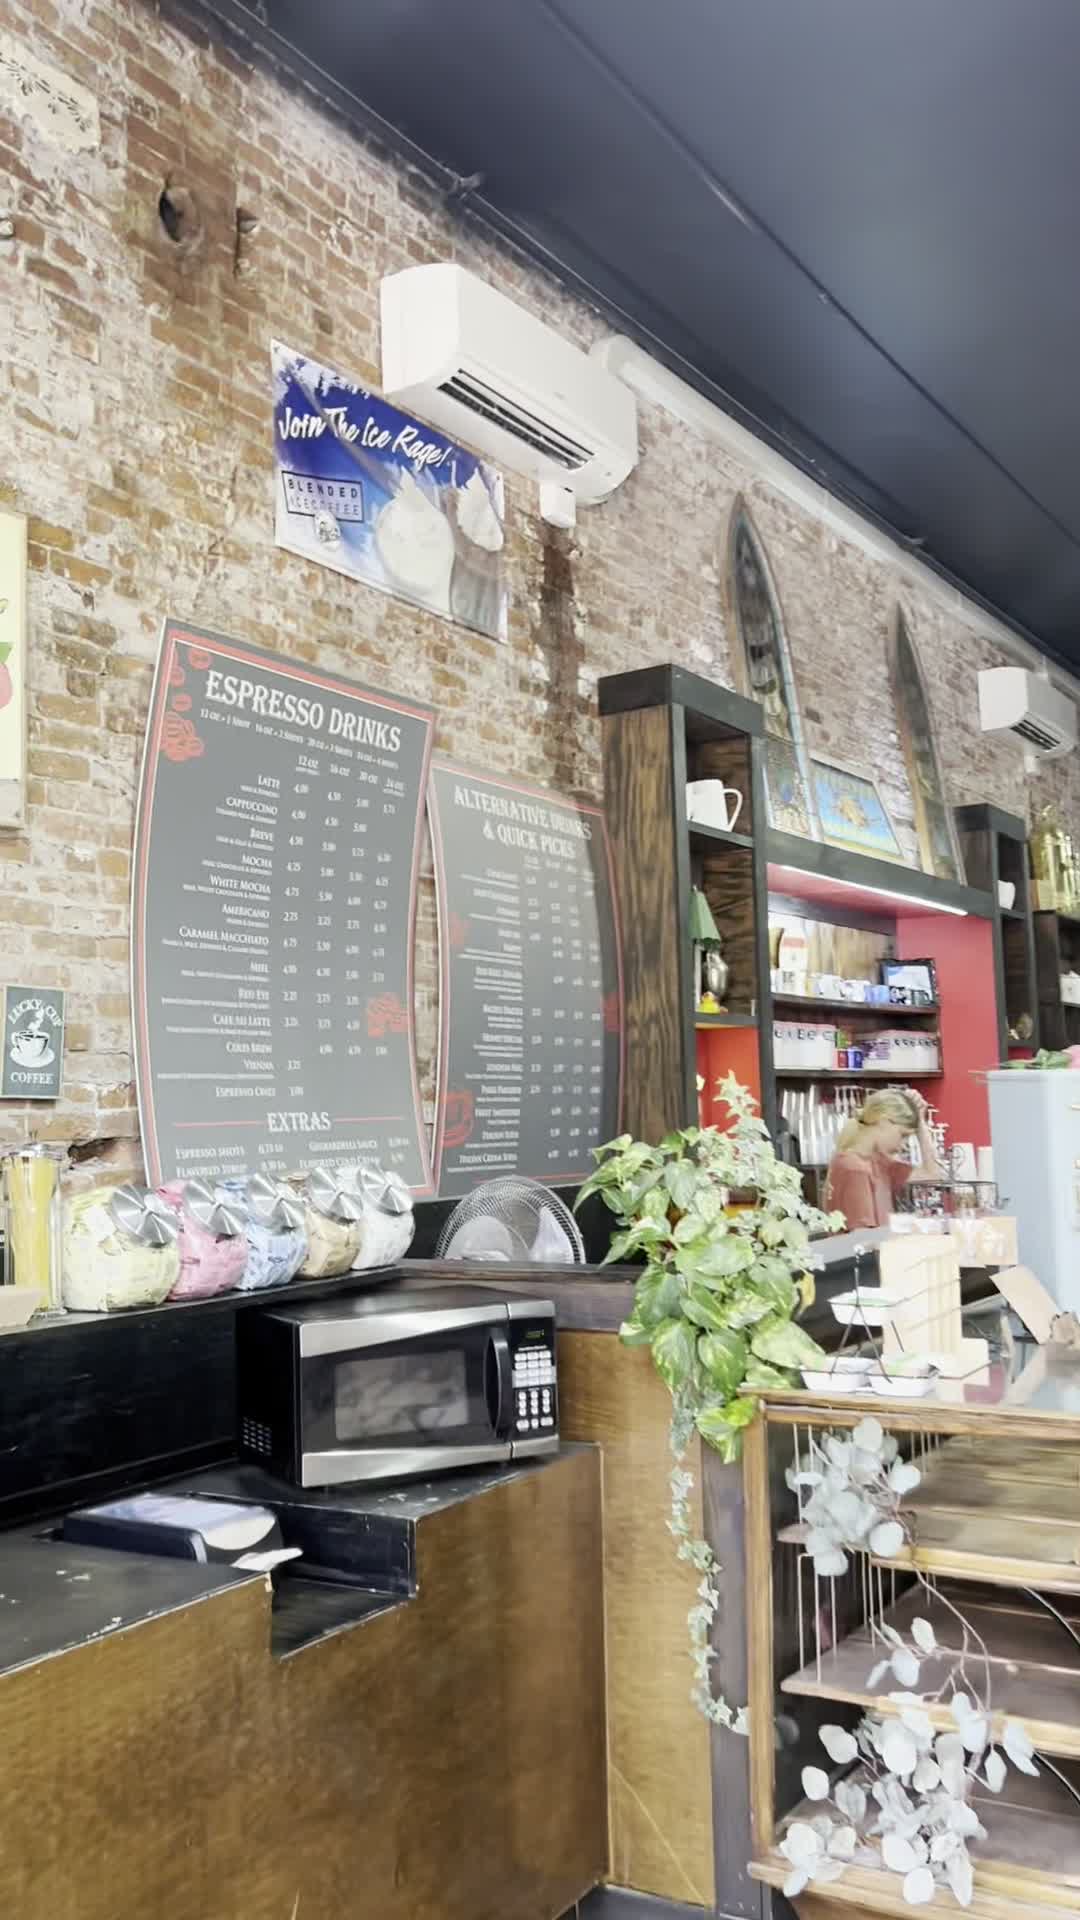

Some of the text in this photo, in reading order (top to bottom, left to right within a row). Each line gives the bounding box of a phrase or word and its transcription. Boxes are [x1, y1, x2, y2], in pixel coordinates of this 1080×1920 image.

[279, 407, 453, 471] Join The Ice Rage!
[288, 478, 358, 499] BLENDED
[206, 669, 401, 752] ESPRESSO DRINKS
[258, 774, 281, 790] LATTE
[226, 796, 278, 816] CAPPUCCINO
[453, 784, 592, 841] ALTERNATIVE DRINKS
[482, 818, 577, 858] & QUICK PICKS
[242, 853, 273, 869] MOCHA
[209, 873, 239, 891] WHITE
[240, 878, 272, 895] MOCHA
[221, 903, 270, 919] AMERICANO
[178, 926, 217, 941] CARAMEL
[219, 930, 269, 946] MACCHIATO
[250, 961, 269, 974] MIEL
[8, 998, 63, 1027] LUCKY CUP
[10, 1071, 55, 1085] COFFEE
[266, 1111, 333, 1134] EXTRAS
